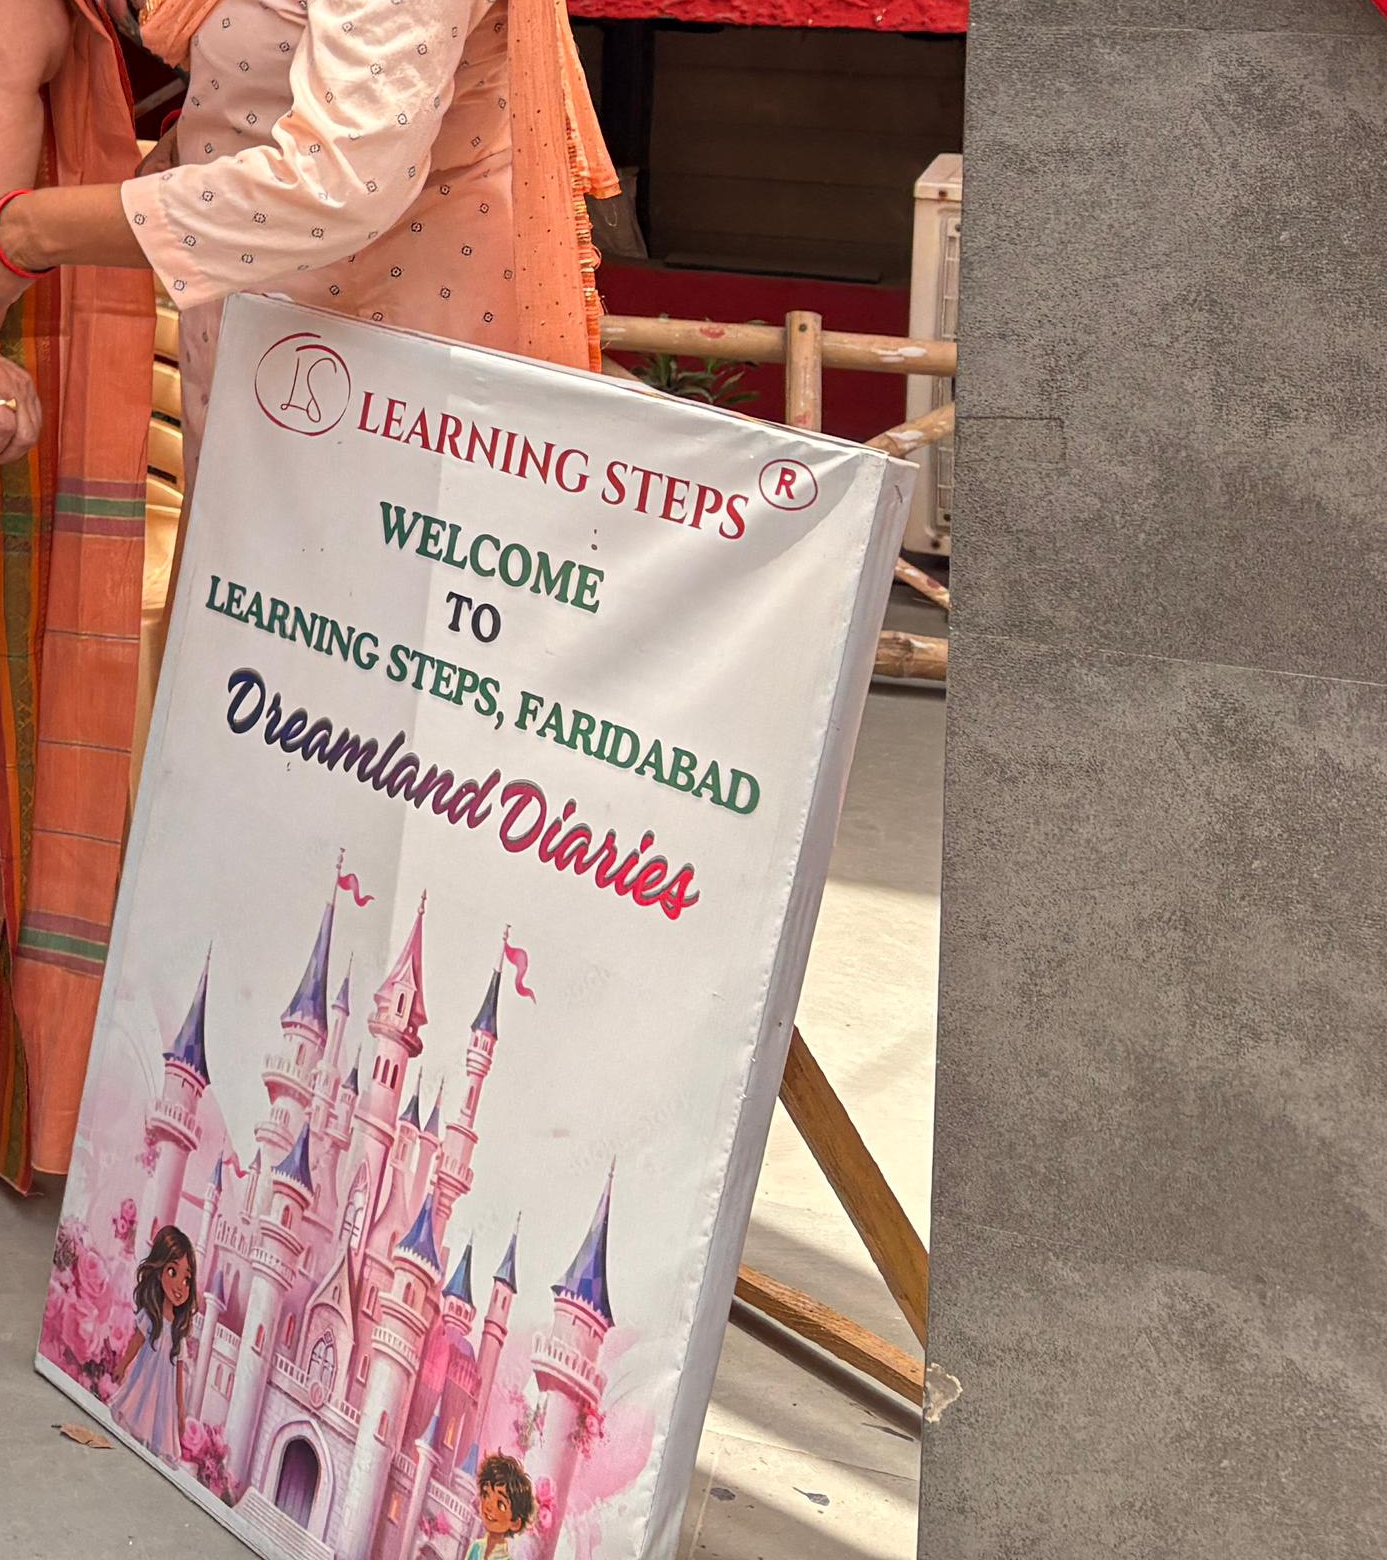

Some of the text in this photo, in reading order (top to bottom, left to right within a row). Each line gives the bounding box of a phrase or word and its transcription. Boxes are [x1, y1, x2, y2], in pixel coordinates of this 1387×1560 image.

[357, 390, 590, 494] LEARNING
[600, 460, 750, 541] STEPS
[379, 501, 605, 615] WELCOME
[445, 590, 503, 644] TO
[205, 574, 761, 817] LEARNING STEPS, FARIDABAD
[226, 666, 702, 921] Dreamland Diaries
